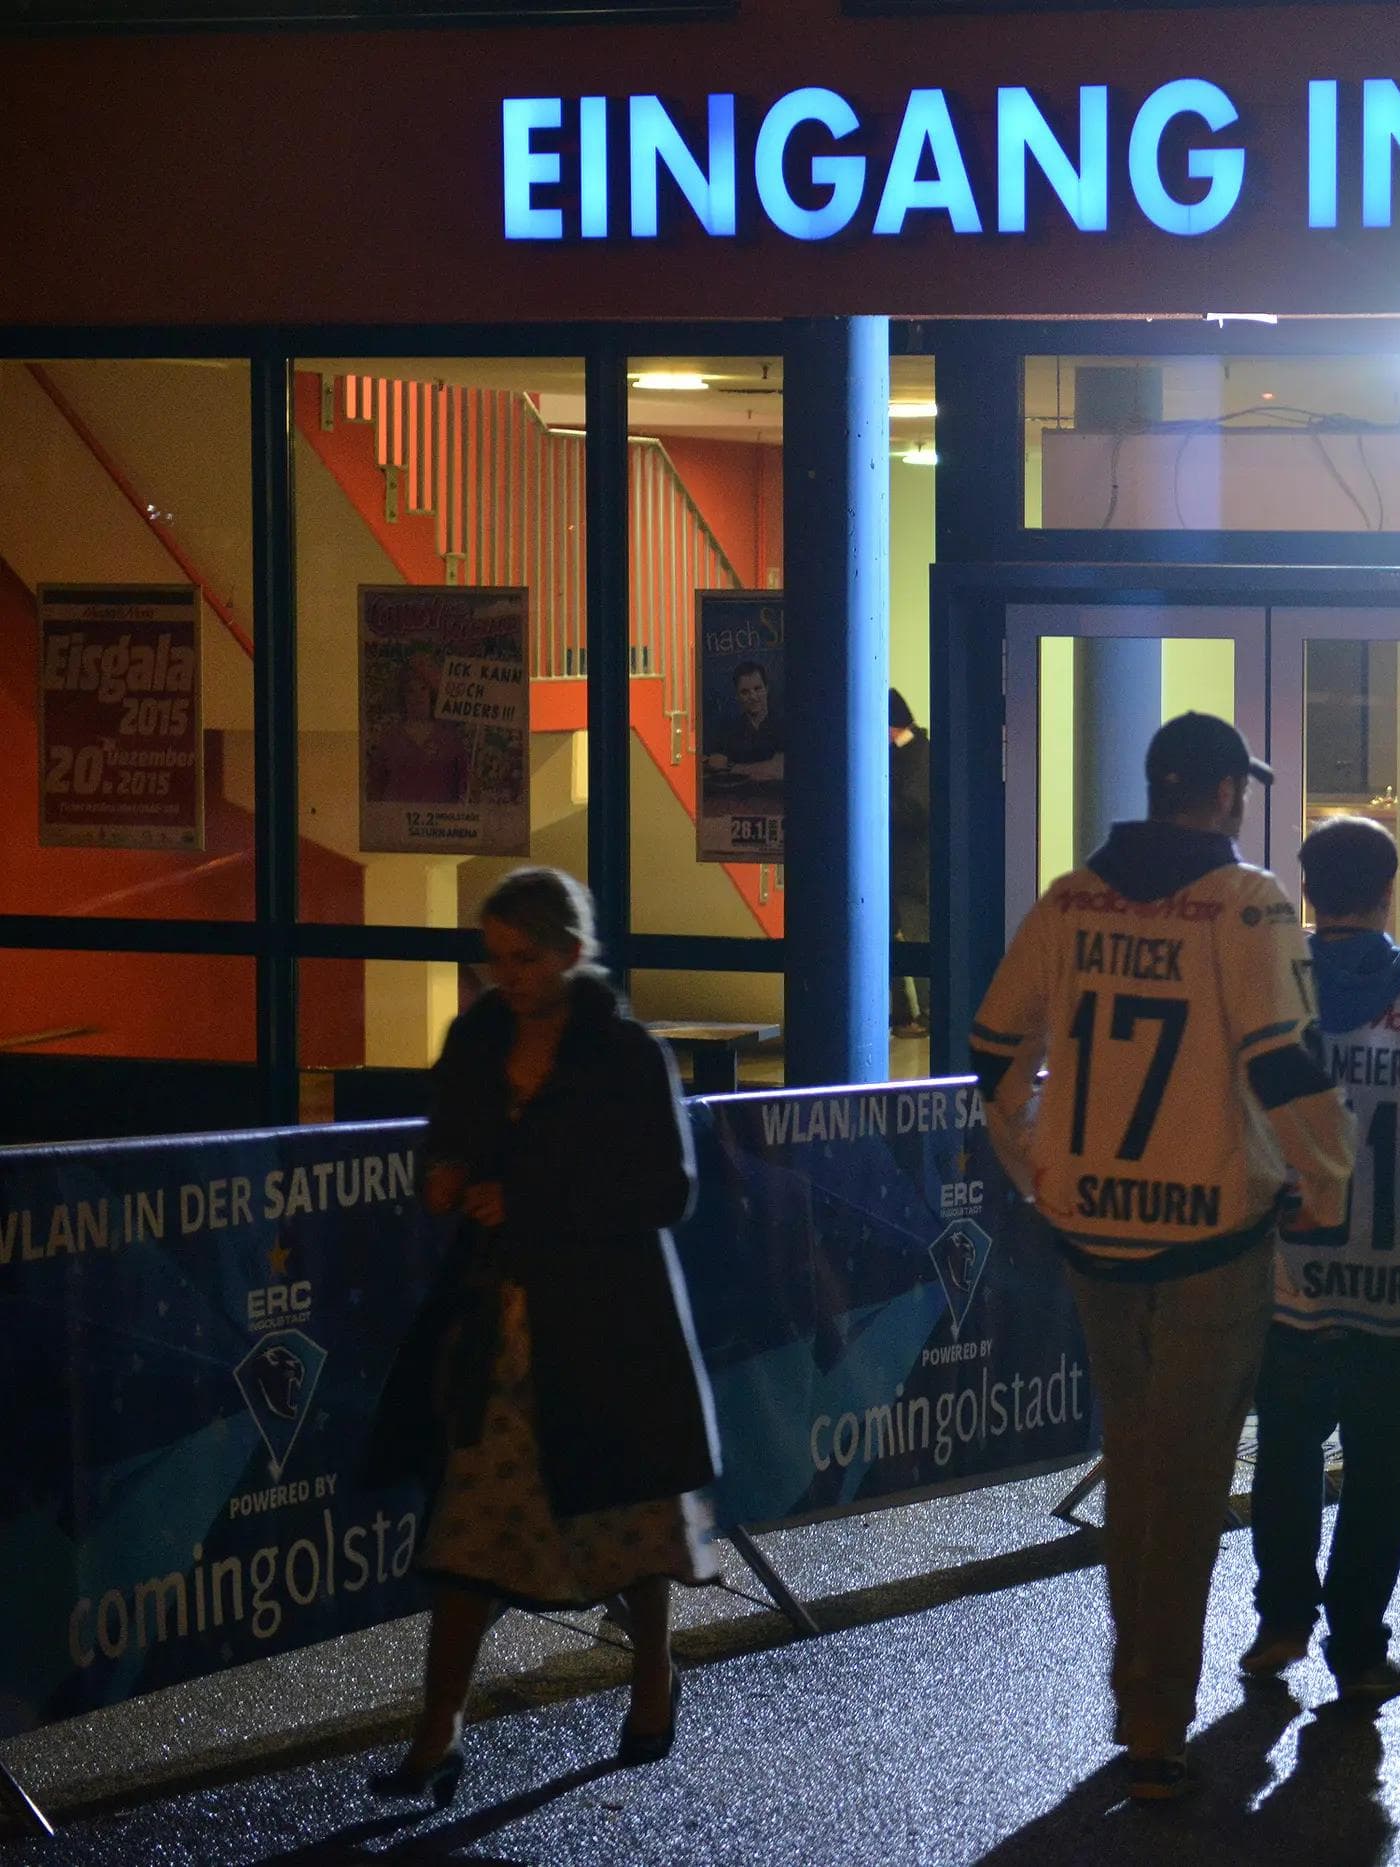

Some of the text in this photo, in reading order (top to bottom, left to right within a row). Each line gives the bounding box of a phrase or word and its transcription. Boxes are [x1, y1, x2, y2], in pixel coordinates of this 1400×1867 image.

[503, 78, 1245, 240] EINGANG
[45, 632, 194, 703] Eisgala
[449, 662, 522, 683] ICK KANN
[119, 698, 190, 736] 2015
[117, 770, 170, 795] 2015
[1069, 990, 1189, 1160] 17
[761, 1099, 850, 1145] WLAN
[859, 1096, 888, 1137] IN
[897, 1091, 947, 1134] DER
[123, 1189, 166, 1243] IN
[180, 1175, 254, 1238] DER
[264, 1150, 416, 1221] SATURN
[940, 1180, 984, 1208] ERC
[1076, 1174, 1221, 1226] SATURN
[248, 1280, 312, 1319] ERC
[922, 1340, 992, 1367] POWERED BY
[810, 1352, 1084, 1472] comingolstadt
[229, 1473, 338, 1519] POWERED BY
